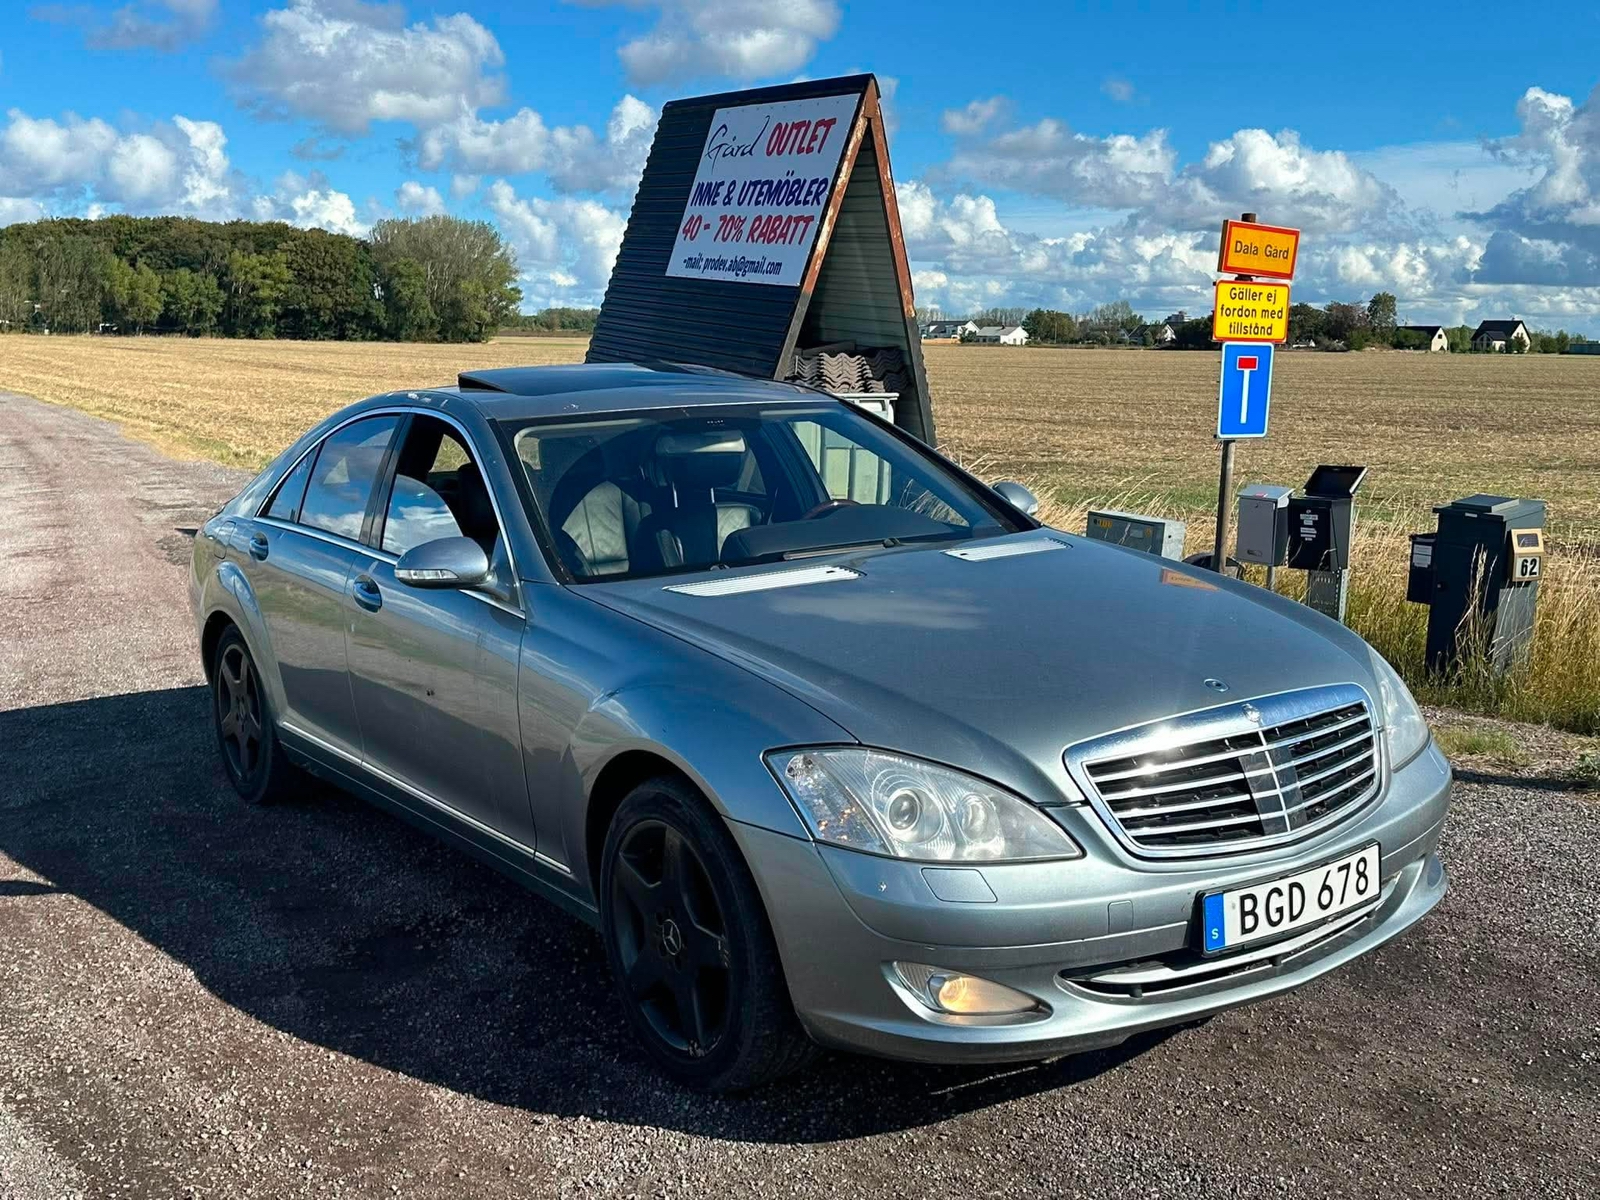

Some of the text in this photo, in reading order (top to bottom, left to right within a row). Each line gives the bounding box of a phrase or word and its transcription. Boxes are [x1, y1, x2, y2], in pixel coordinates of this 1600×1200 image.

[765, 117, 837, 157] OUTLET
[690, 170, 829, 207] INNE & UTEMÖBLER
[682, 214, 702, 242] 40
[713, 214, 747, 242] 70%
[746, 215, 815, 245] RABATT
[1234, 240, 1290, 260] Dala Gård
[1229, 287, 1277, 305] Gäller ej
[1220, 304, 1283, 319] fordon med
[1228, 320, 1273, 336] tillstånd
[1521, 558, 1537, 576] 62
[1239, 856, 1369, 935] BGD 678
[1211, 928, 1219, 940] S
